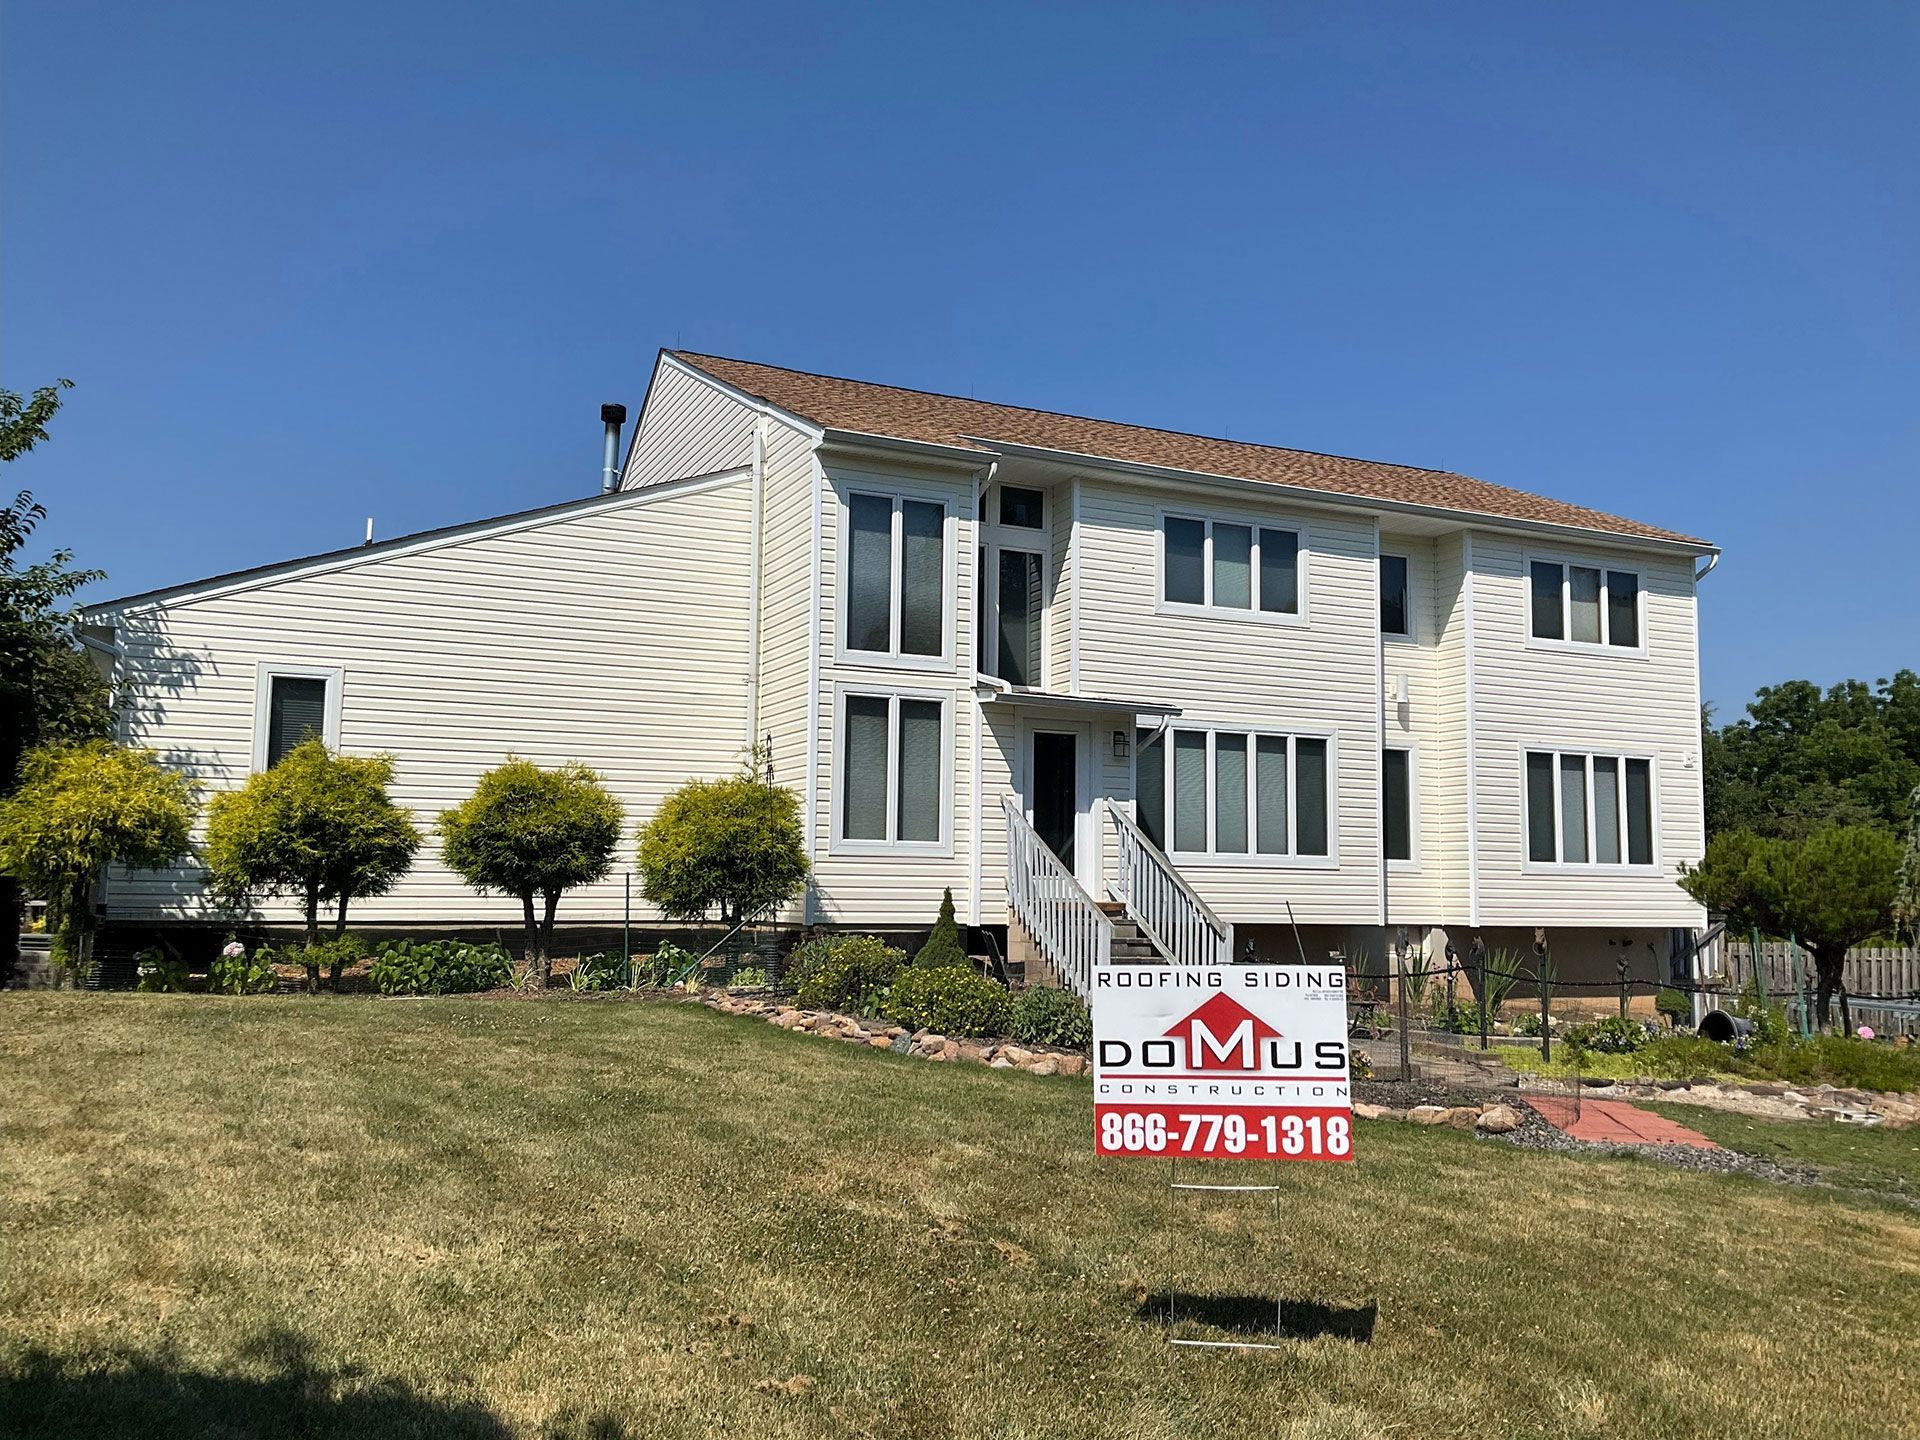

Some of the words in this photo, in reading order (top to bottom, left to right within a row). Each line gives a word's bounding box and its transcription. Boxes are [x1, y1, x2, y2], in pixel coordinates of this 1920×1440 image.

[1098, 972, 1222, 988] ROOFING
[1244, 972, 1343, 988] SIDING
[1099, 1019, 1345, 1070] DOMUS
[1100, 1084, 1347, 1097] CONSTRUCTION
[1101, 1112, 1349, 1155] 866-779-1318
